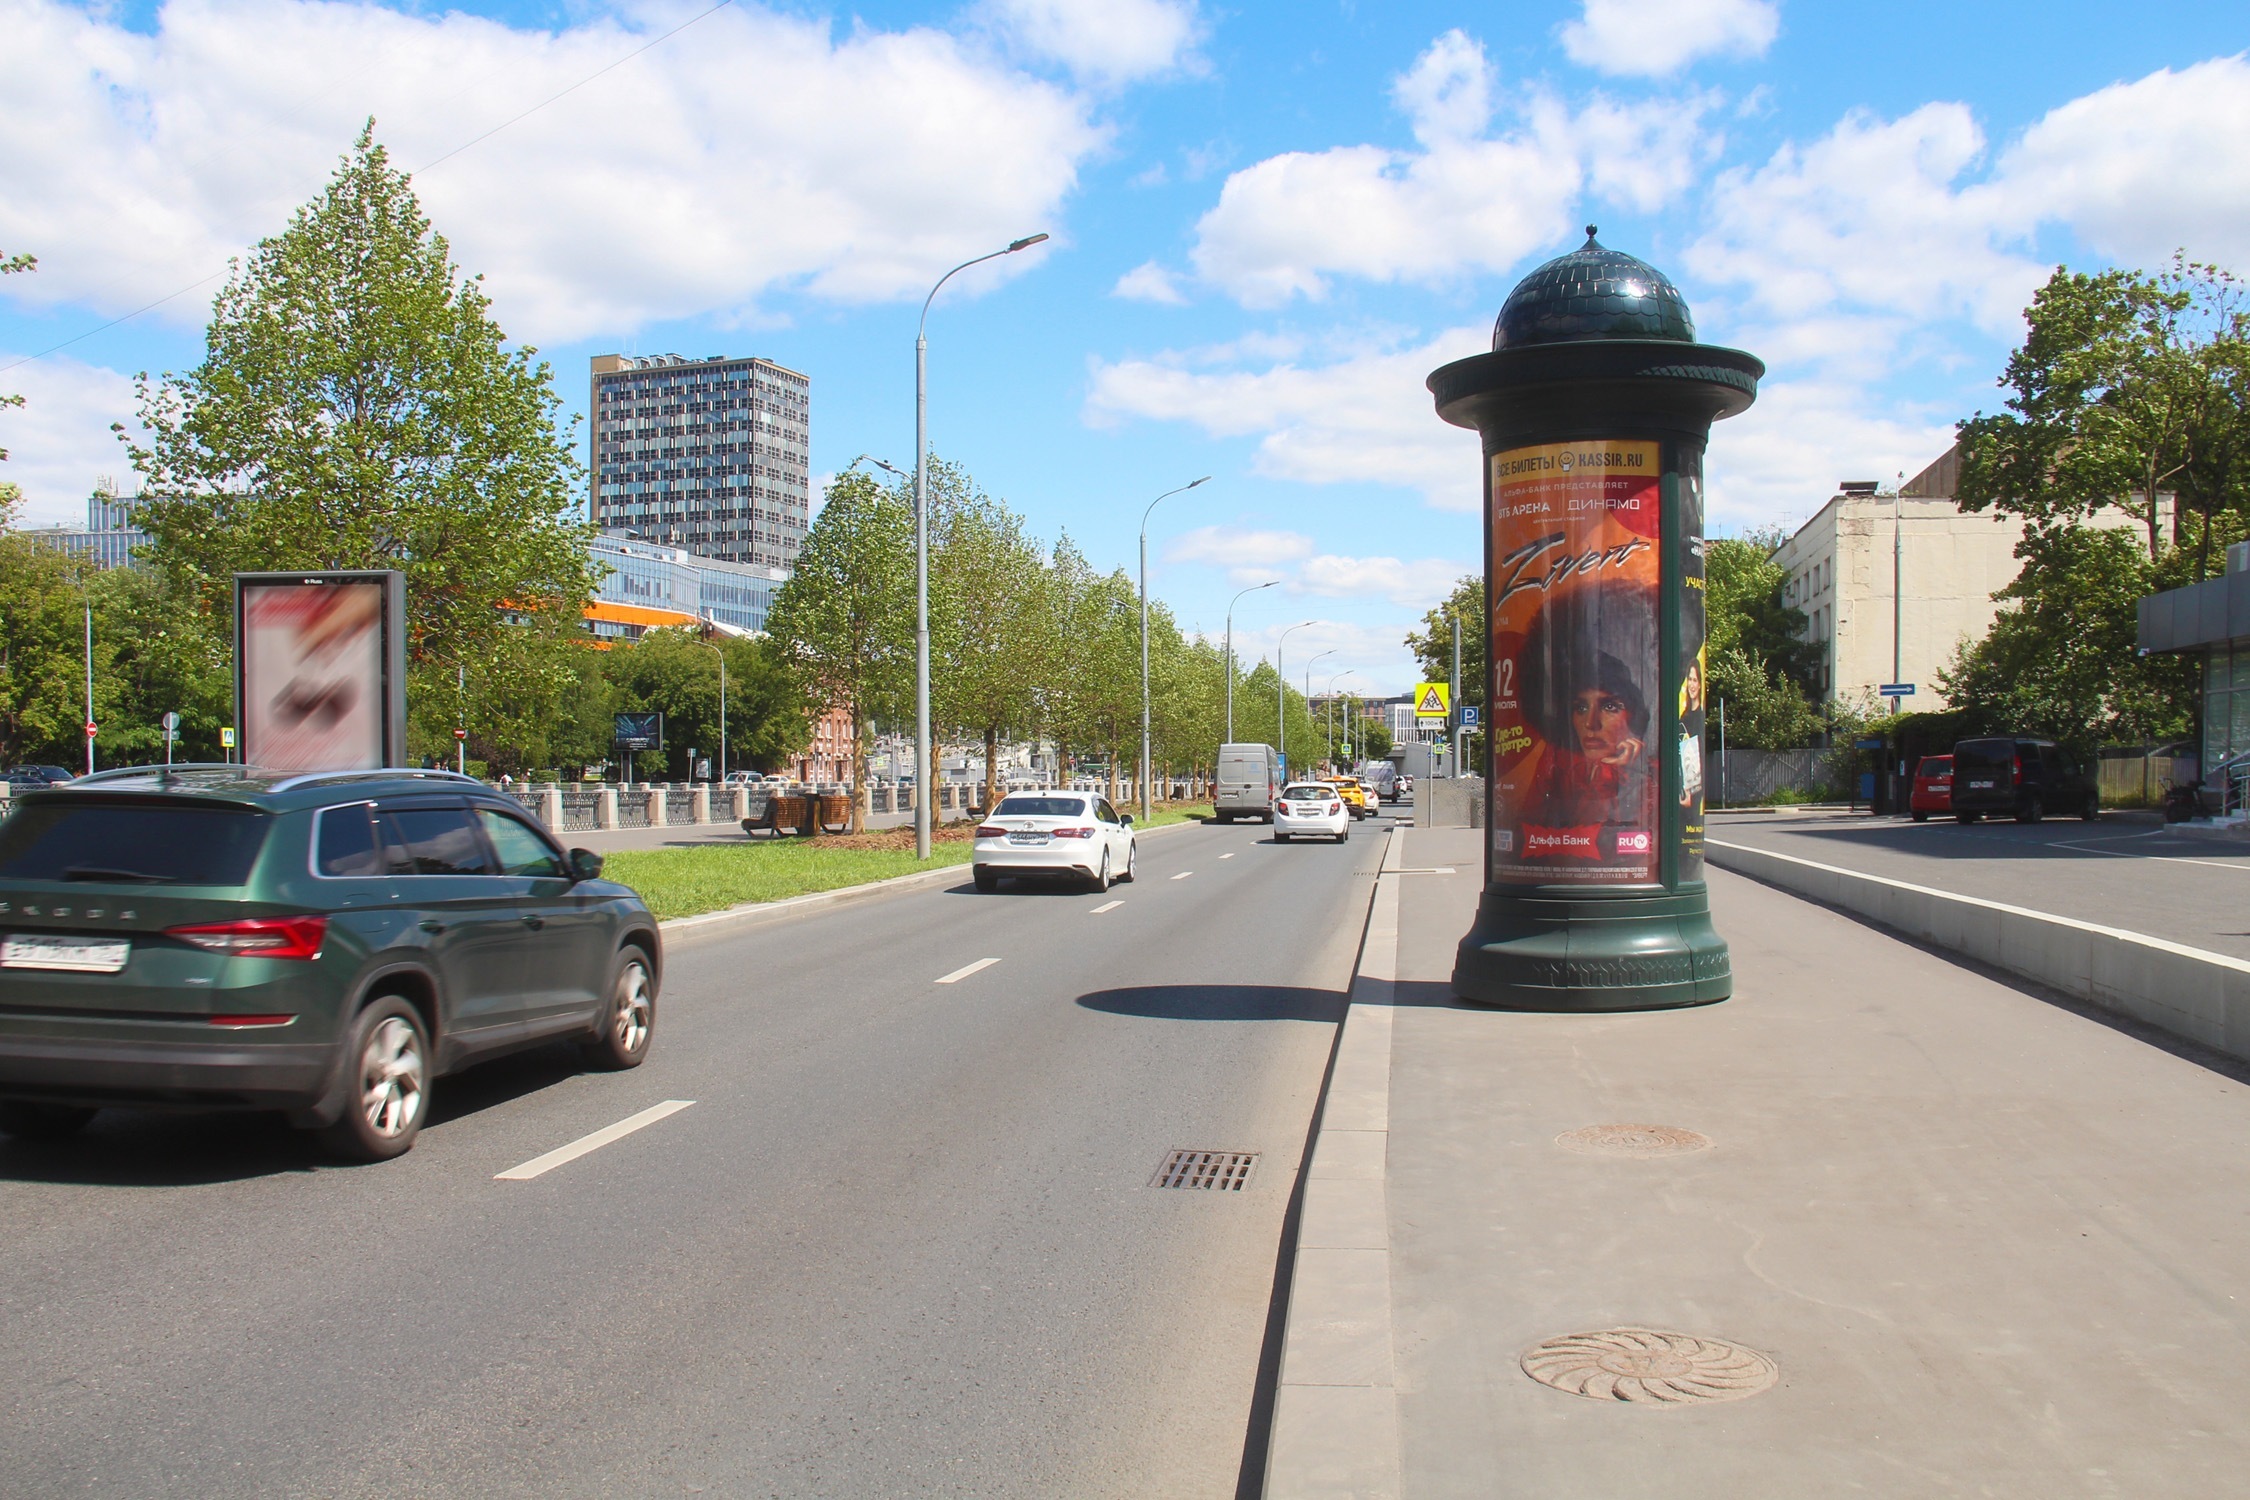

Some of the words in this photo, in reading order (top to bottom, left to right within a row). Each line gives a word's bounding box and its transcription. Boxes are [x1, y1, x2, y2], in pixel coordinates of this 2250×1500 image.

[1497, 463, 1510, 477] ВСЕ
[1512, 456, 1554, 474] БИЛЕТЫ
[1579, 452, 1643, 468] KASSIR.RU
[1504, 484, 1551, 497] АЛЬФА-БАНК
[1554, 482, 1629, 491] ПРЕДСТАВЛЯЕТ
[1498, 507, 1511, 519] ВТБ
[1512, 502, 1551, 516] АРЕНА
[1567, 499, 1640, 511] ДИНАМО
[1496, 531, 1650, 611] Zivert
[1495, 658, 1513, 697] 12
[1529, 834, 1561, 848] Альфа
[1562, 835, 1590, 846] Банк
[1618, 838, 1634, 846] RU
